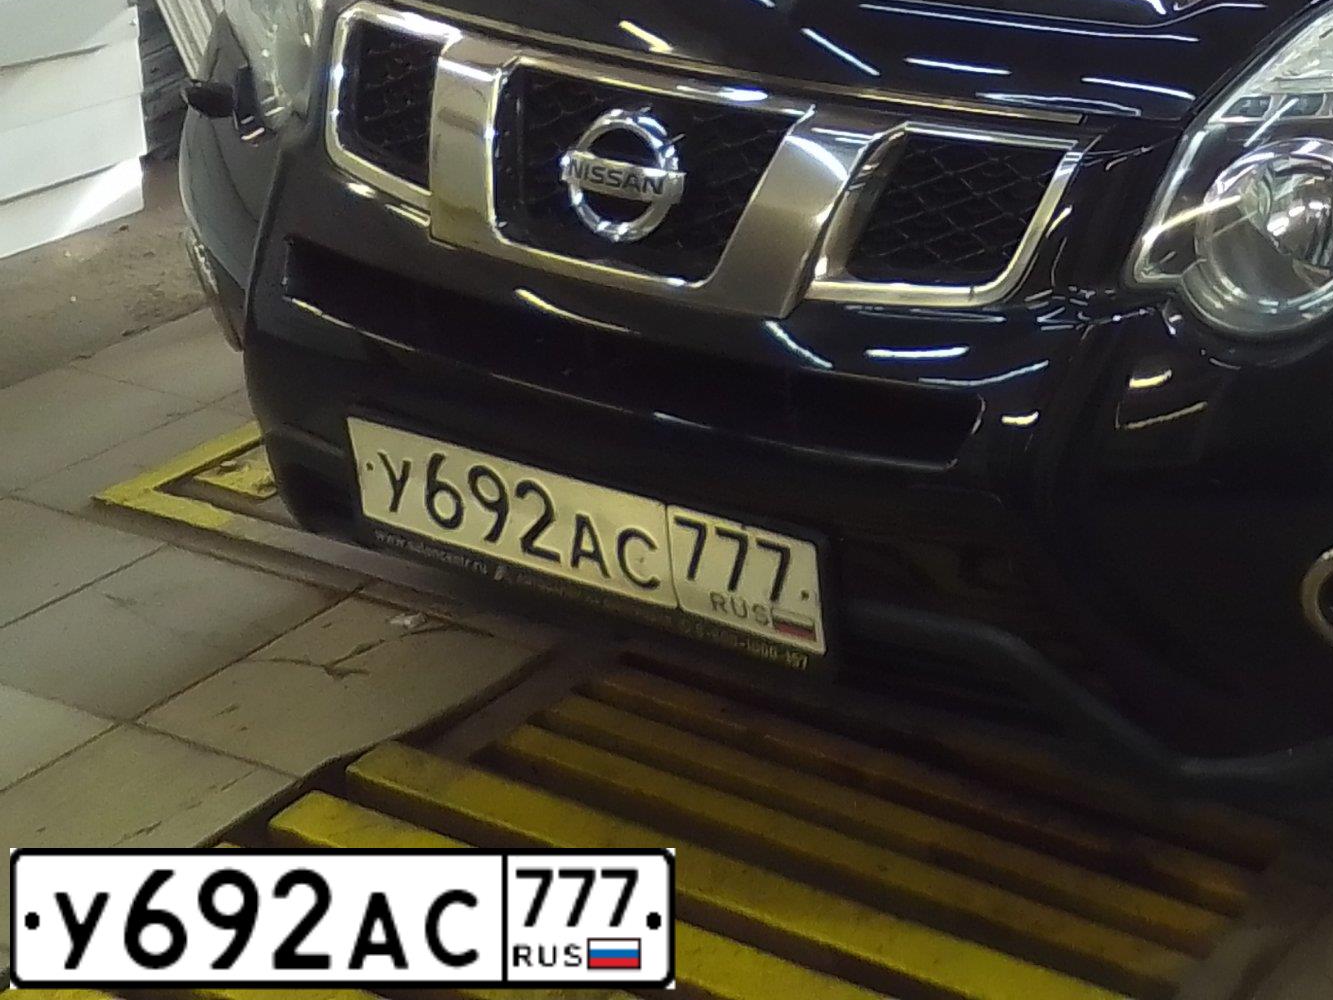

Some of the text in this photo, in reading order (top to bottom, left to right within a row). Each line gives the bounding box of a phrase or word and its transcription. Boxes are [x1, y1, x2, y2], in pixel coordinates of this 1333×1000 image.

[568, 158, 665, 195] NISSAN
[376, 452, 662, 591] У692АС
[673, 516, 792, 602] 777
[709, 592, 771, 628] RUS
